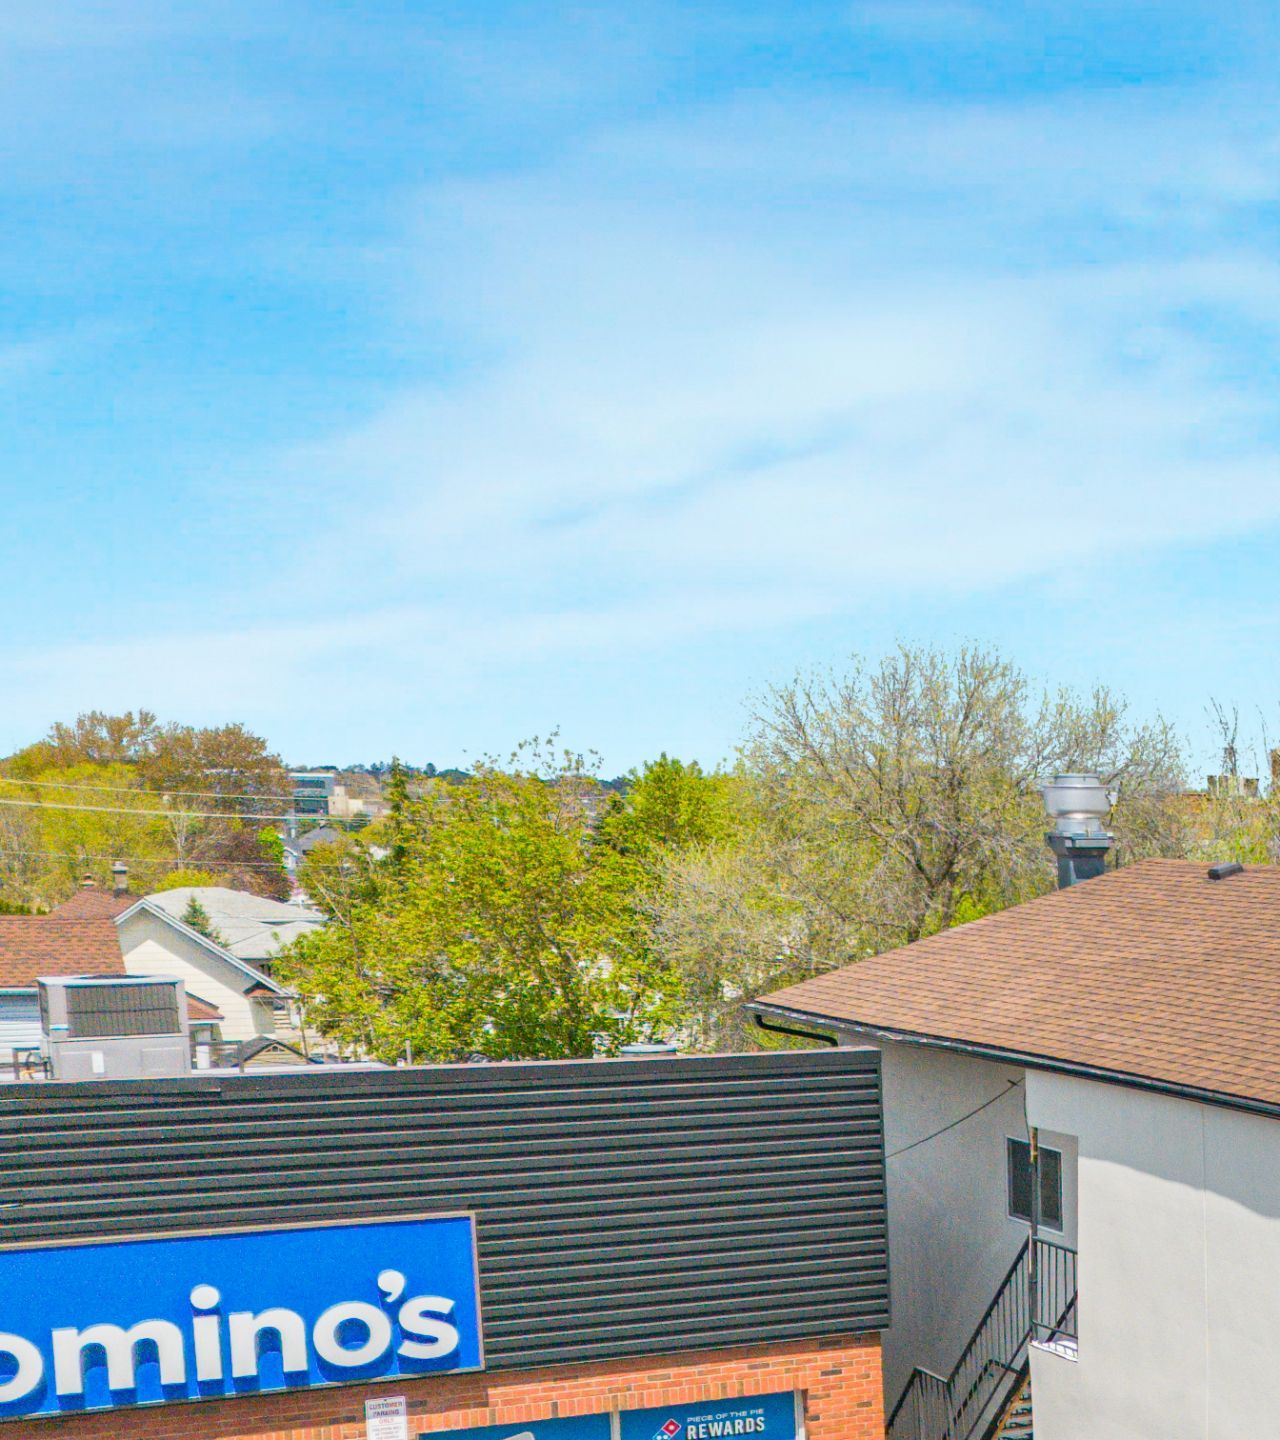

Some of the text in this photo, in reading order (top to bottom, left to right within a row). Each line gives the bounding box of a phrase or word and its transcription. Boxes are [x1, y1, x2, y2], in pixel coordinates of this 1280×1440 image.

[686, 1408, 765, 1424] PIECE OF THE PIE
[686, 1416, 765, 1440] REWARDS
